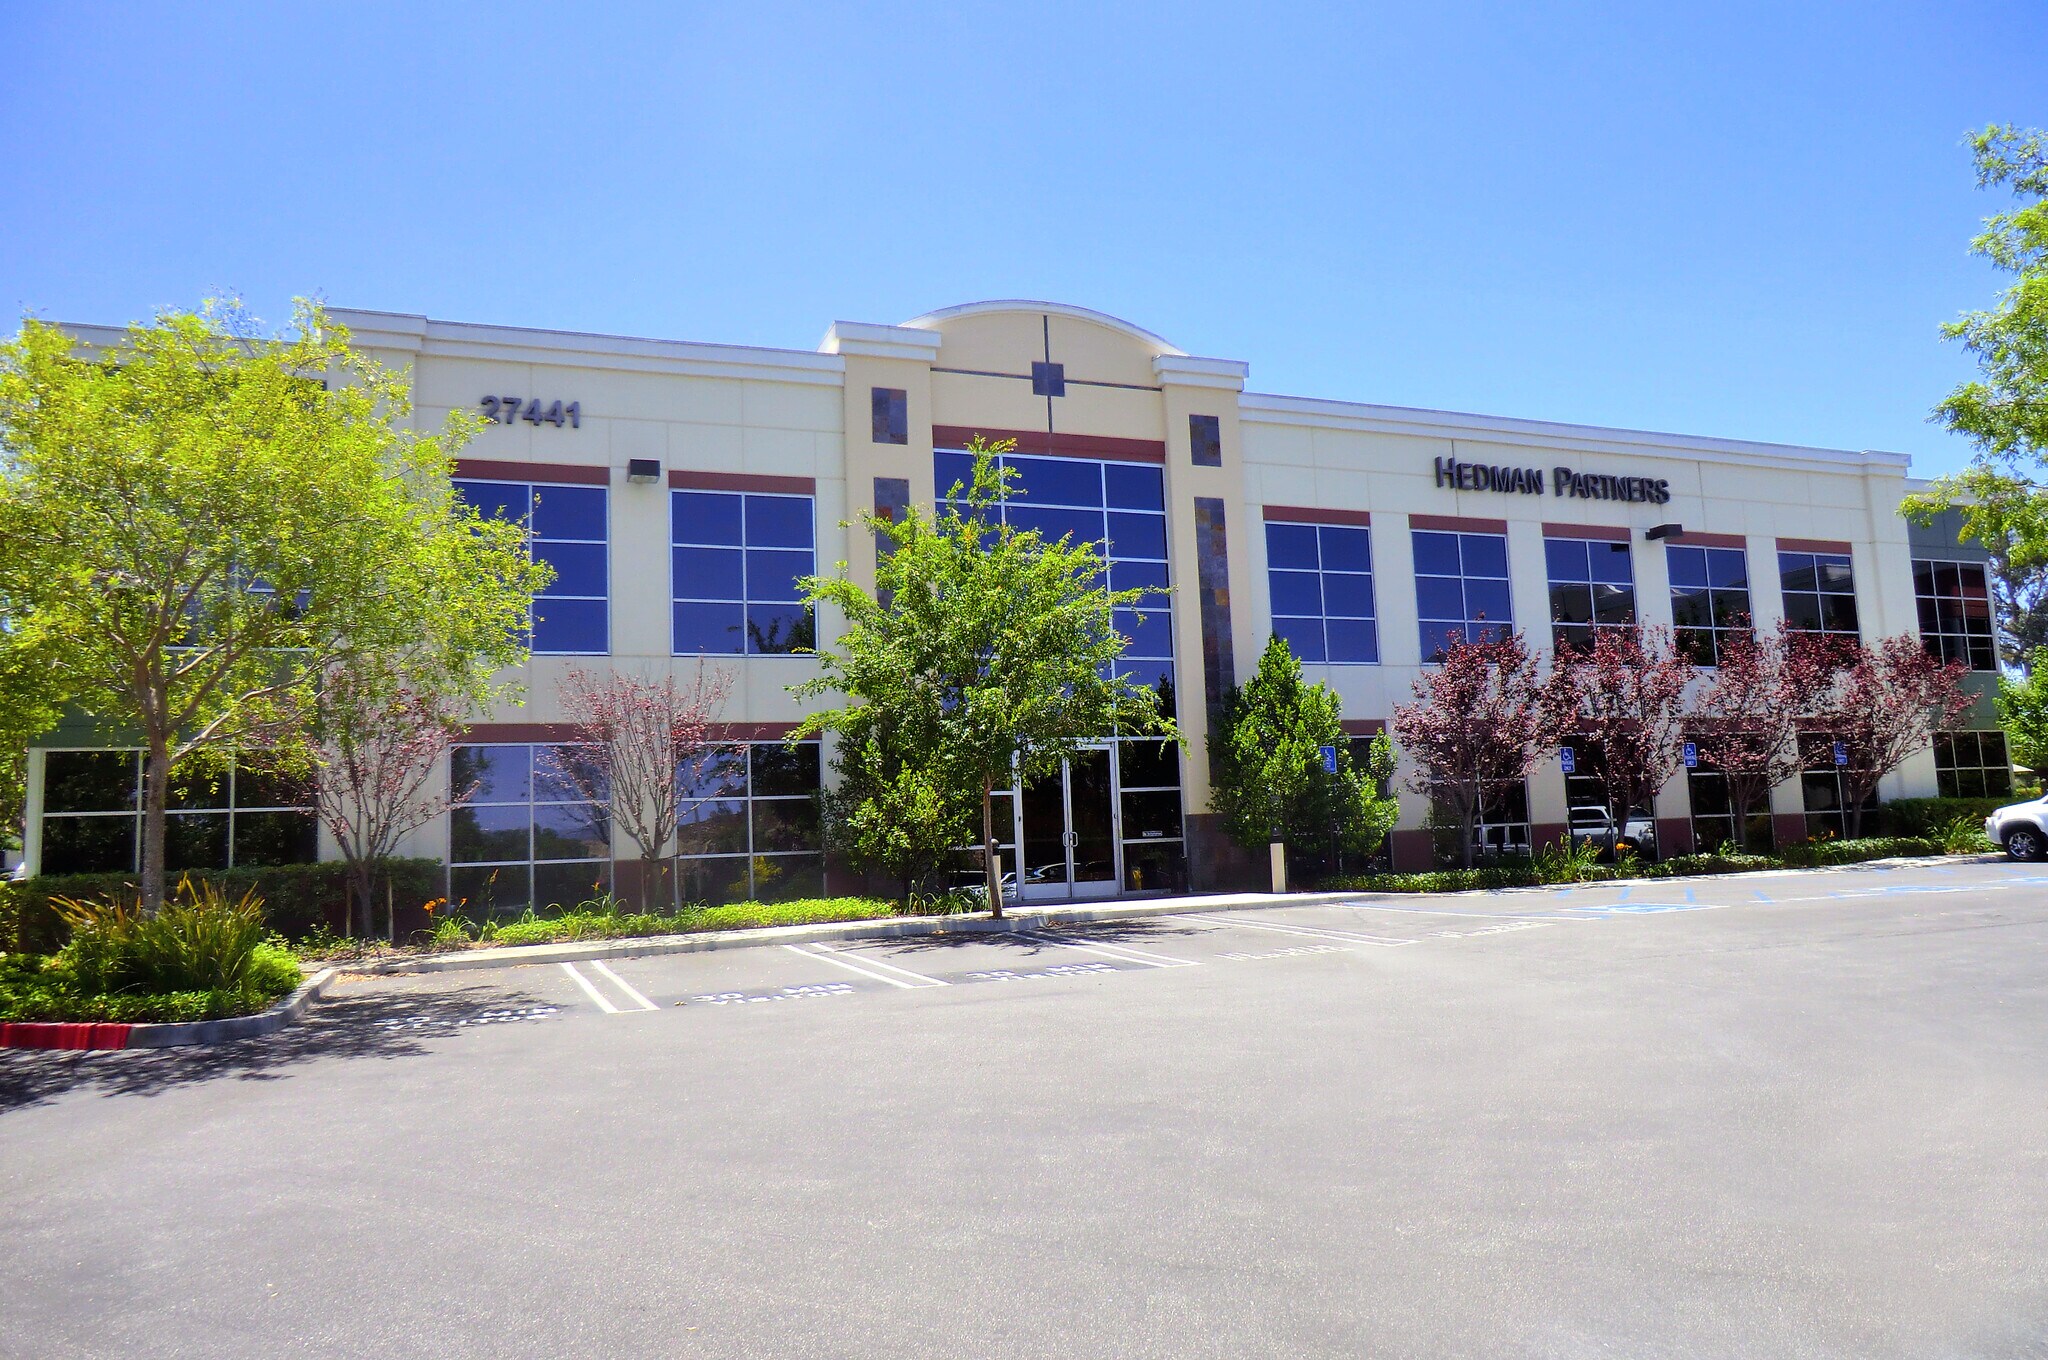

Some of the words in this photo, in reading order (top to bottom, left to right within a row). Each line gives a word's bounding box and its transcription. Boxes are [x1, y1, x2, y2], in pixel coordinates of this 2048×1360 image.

[480, 395, 581, 429] 27441
[1434, 456, 1544, 495] HEDMAN
[1553, 466, 1671, 505] PARTNERS
